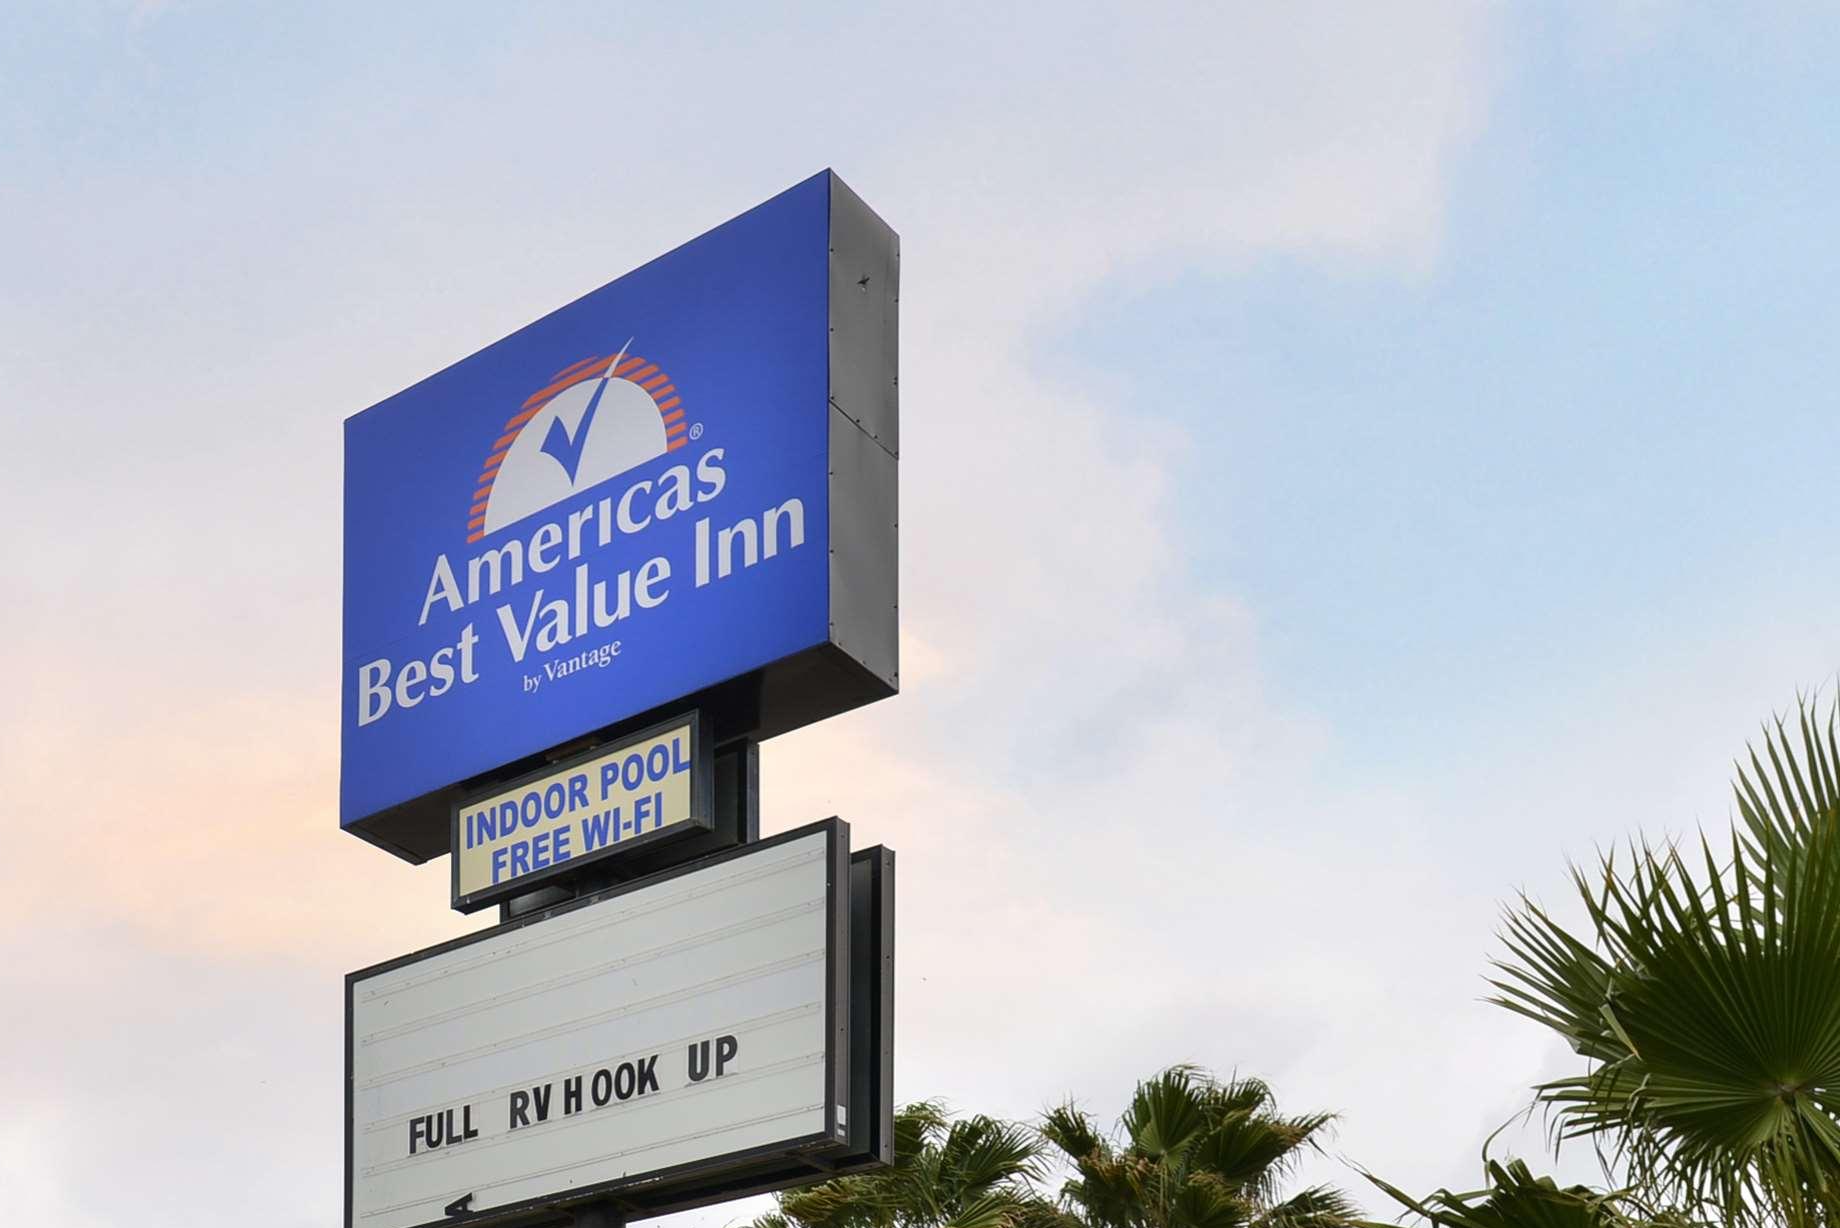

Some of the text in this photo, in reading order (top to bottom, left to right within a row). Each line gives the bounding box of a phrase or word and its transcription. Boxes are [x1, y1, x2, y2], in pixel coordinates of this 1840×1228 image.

[418, 447, 727, 626] Americas
[358, 497, 805, 728] Best Value Inn
[523, 640, 622, 693] by Vantage
[466, 737, 691, 850] INDOOR POOL
[492, 791, 663, 885] FREE WI-FI
[409, 1034, 738, 1155] FULL RV HOOK UP
